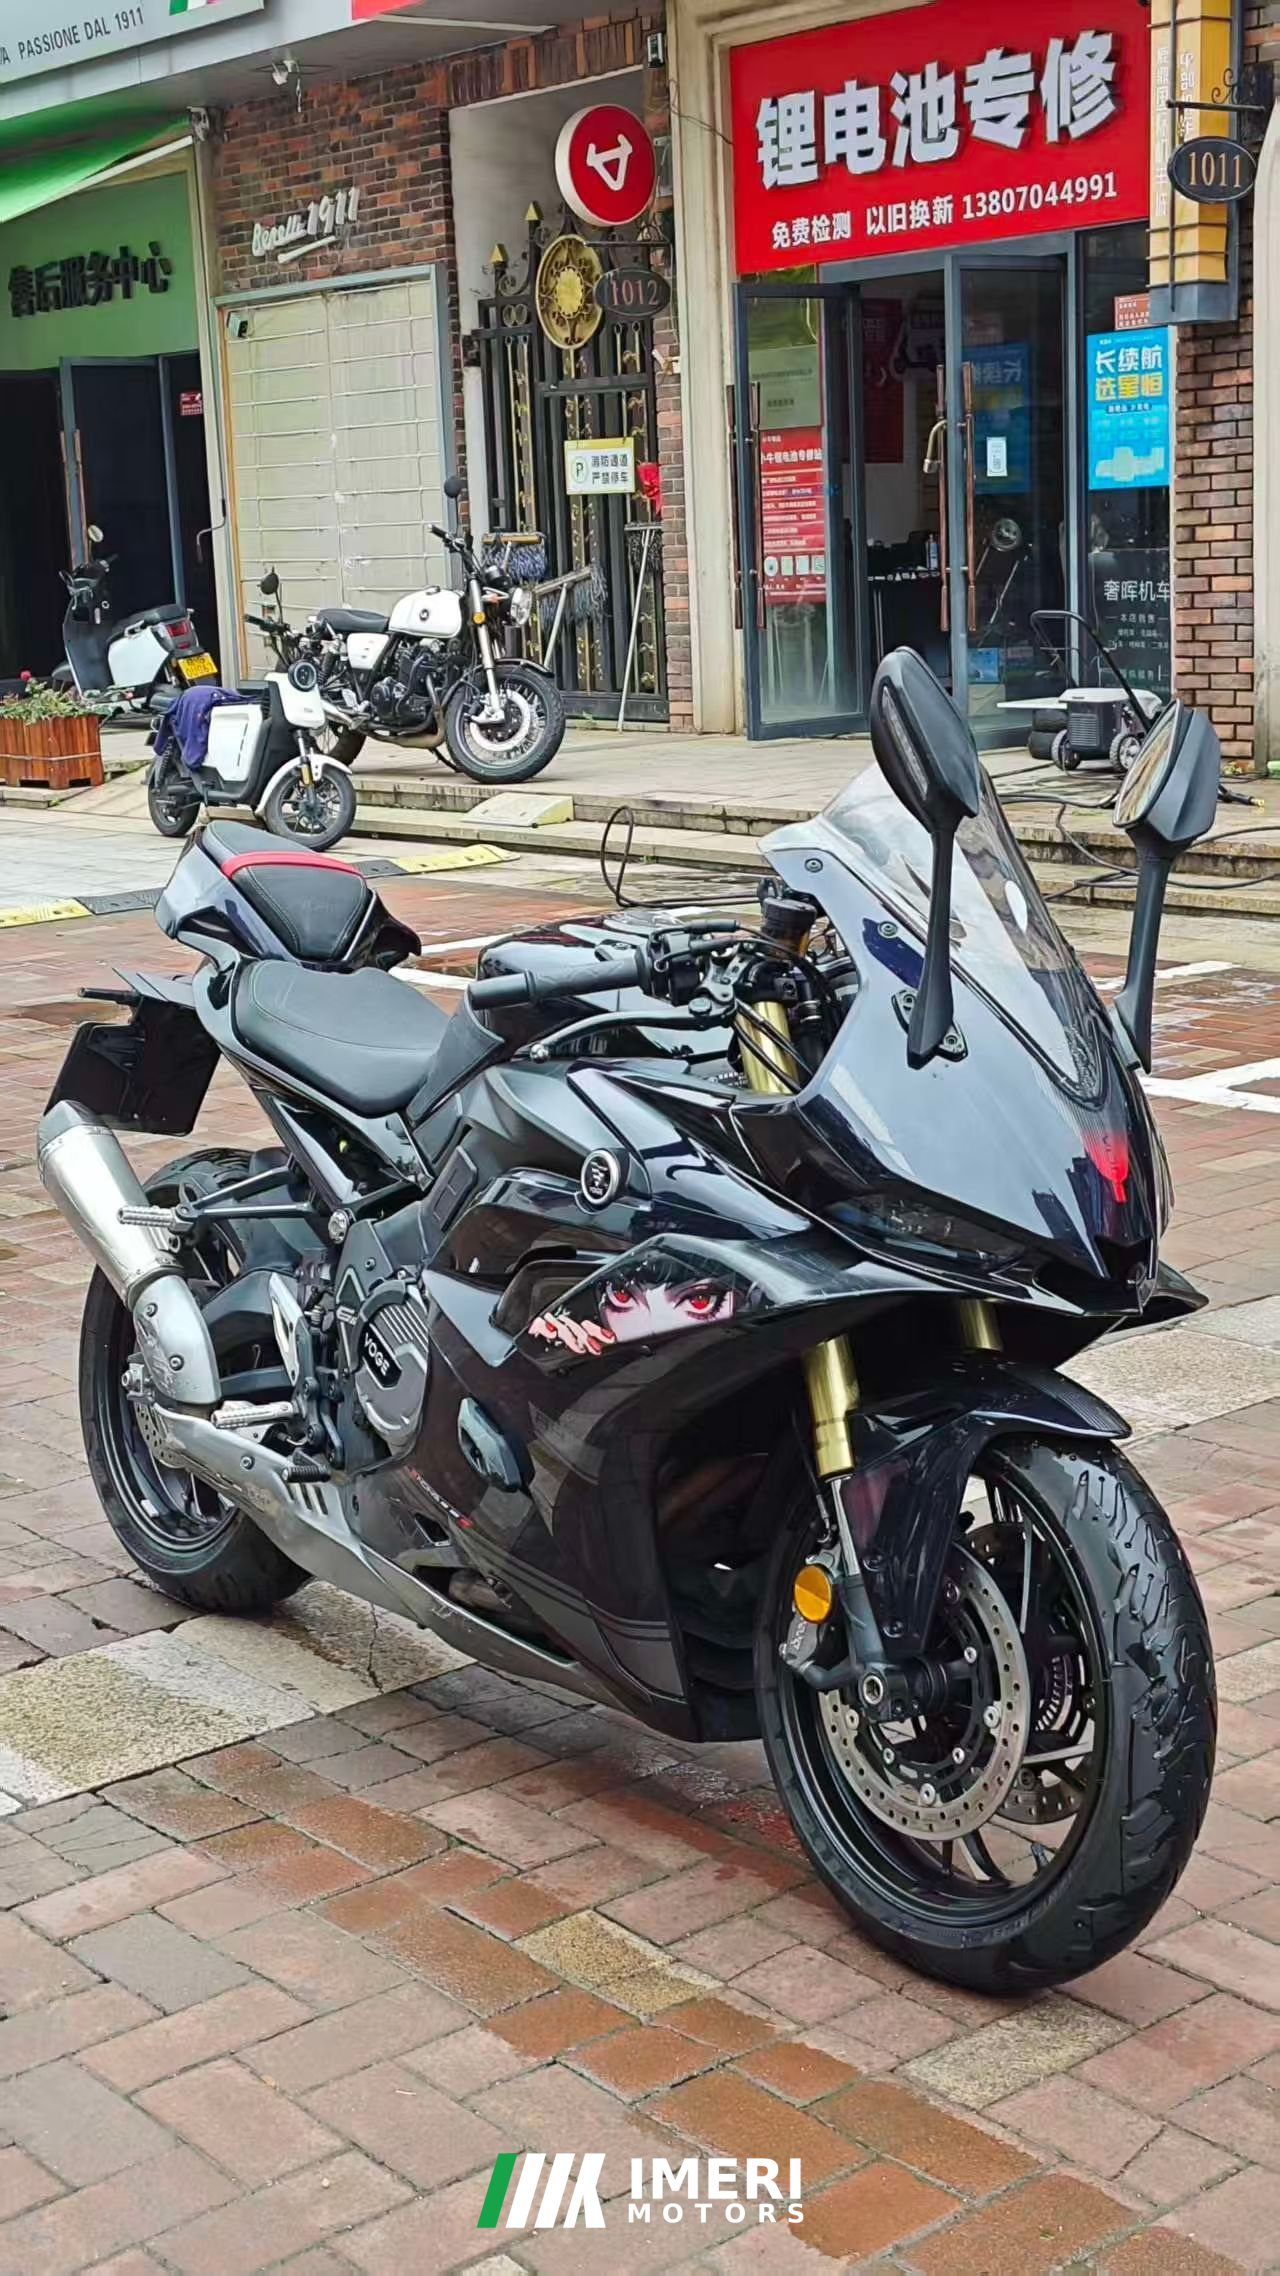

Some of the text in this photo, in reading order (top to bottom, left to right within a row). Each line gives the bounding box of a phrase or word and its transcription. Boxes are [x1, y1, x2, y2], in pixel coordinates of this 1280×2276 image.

[17, 25, 81, 60] PASSIONE
[83, 17, 111, 40] DAL
[114, 7, 144, 31] 1911
[755, 30, 1118, 190] 锂电池专修
[1188, 151, 1242, 188] 1011
[306, 186, 361, 236] 1911
[771, 172, 1117, 249] 免费检测 以旧换新 13807044991
[8, 241, 173, 318] 售后服务中心
[610, 279, 660, 306] 1012
[1095, 344, 1163, 374] 长续航
[592, 471, 629, 485] 严禁停车
[1103, 579, 1170, 602] 奢晖机车
[364, 1332, 390, 1376] VOGE
